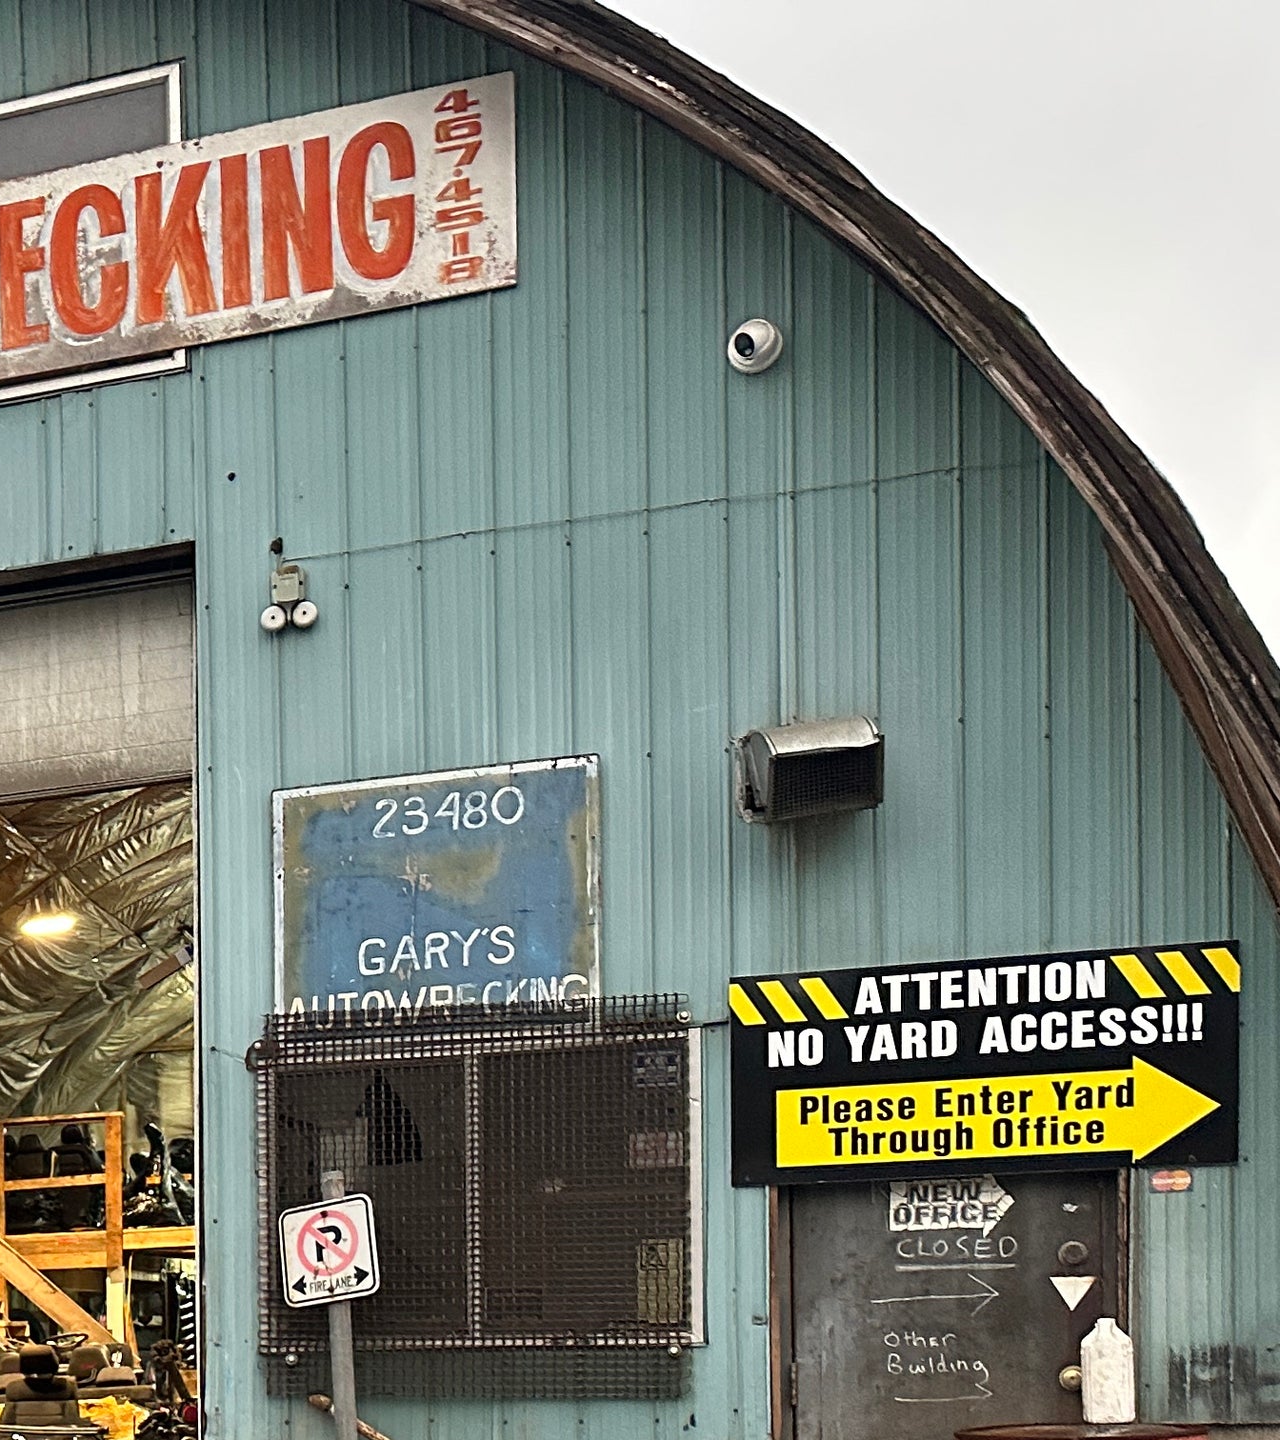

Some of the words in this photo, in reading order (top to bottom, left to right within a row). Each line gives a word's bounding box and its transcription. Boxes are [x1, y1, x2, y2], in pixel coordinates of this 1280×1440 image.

[372, 786, 525, 839] 23480
[357, 926, 516, 977] GARY'S
[853, 959, 1106, 1016] ATTENTION
[767, 1027, 824, 1068] NO
[844, 1020, 958, 1063] YARD
[979, 1003, 1204, 1055] ACCESS!!!
[799, 1095, 916, 1125] Please
[935, 1087, 1033, 1118] Enter
[1051, 1076, 1135, 1111] Yard
[828, 1120, 974, 1157] Through
[991, 1116, 1105, 1148] Office
[906, 1181, 982, 1201] NEW
[893, 1203, 1000, 1226] OFFICE
[896, 1235, 1018, 1259] CLOSED
[309, 1279, 328, 1294] FIRE
[887, 1353, 990, 1386] Building
